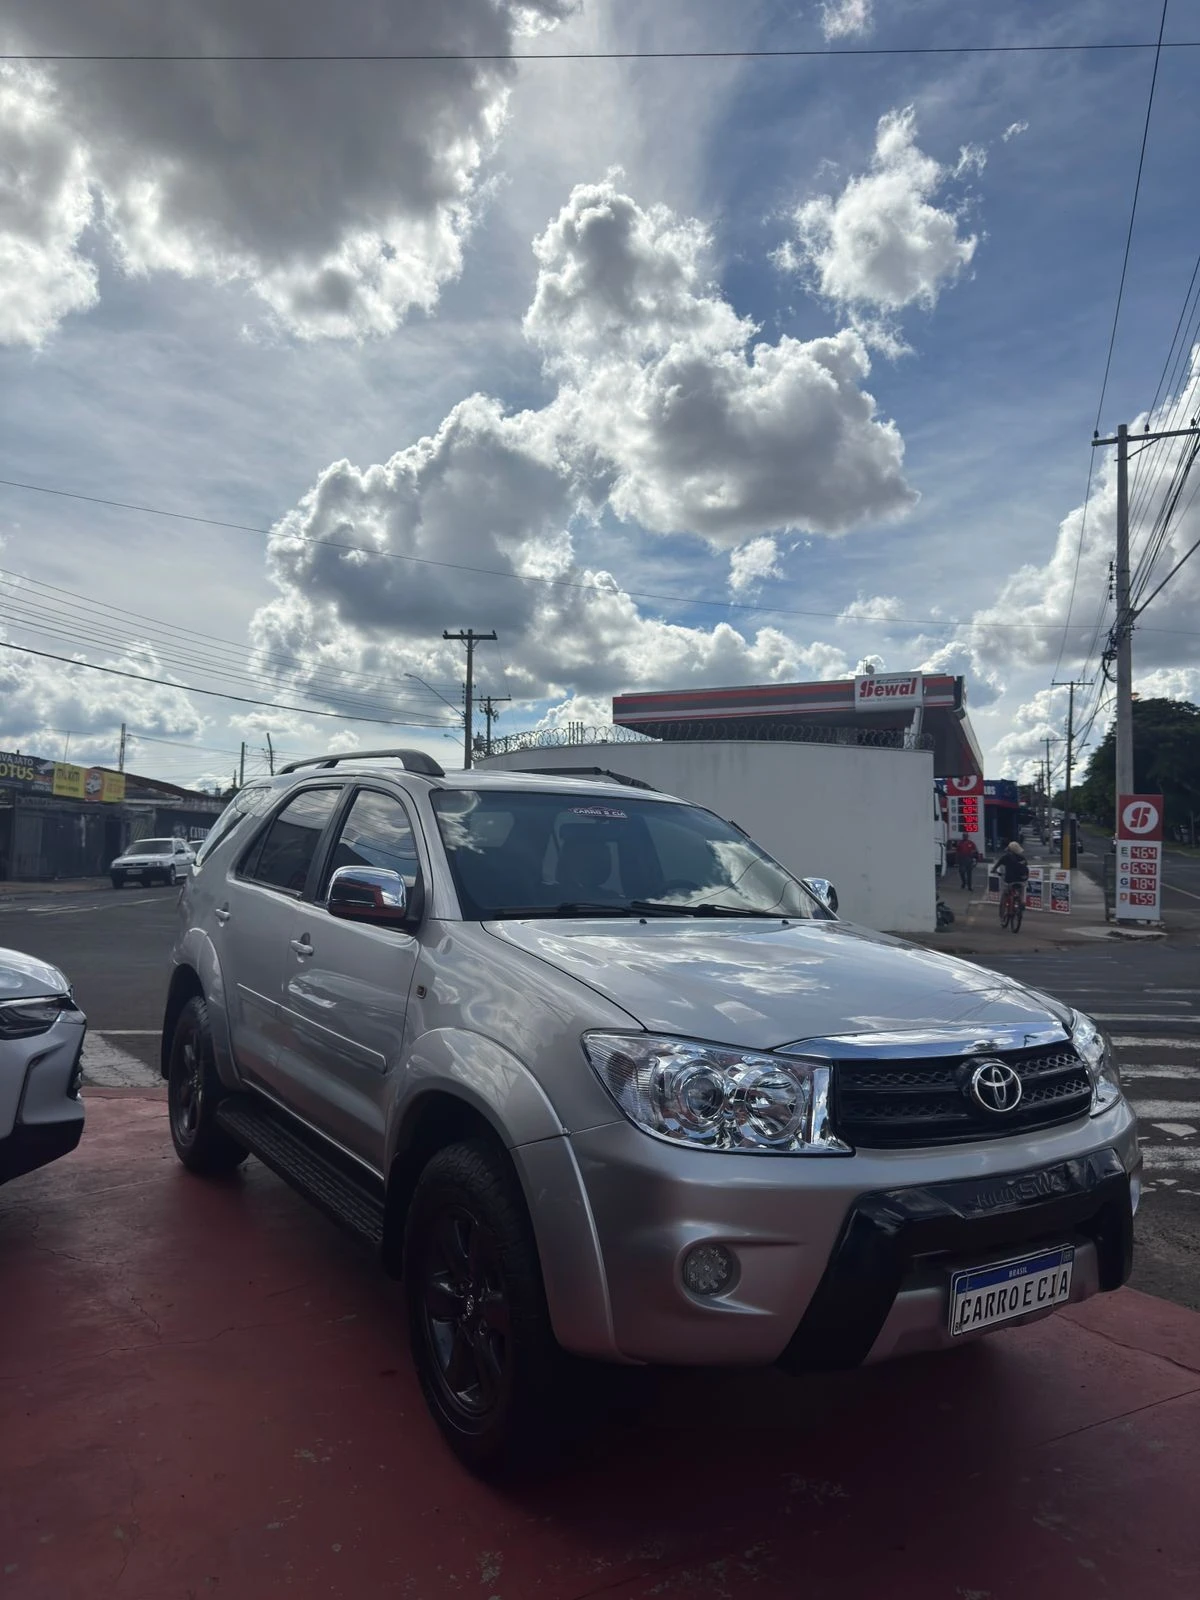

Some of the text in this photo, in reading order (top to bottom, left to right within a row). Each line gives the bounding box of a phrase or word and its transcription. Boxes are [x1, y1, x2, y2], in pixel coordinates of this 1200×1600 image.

[859, 677, 917, 697] Sewal
[1121, 863, 1129, 871] G
[1120, 877, 1128, 886] G
[1008, 1267, 1028, 1278] BRASIL
